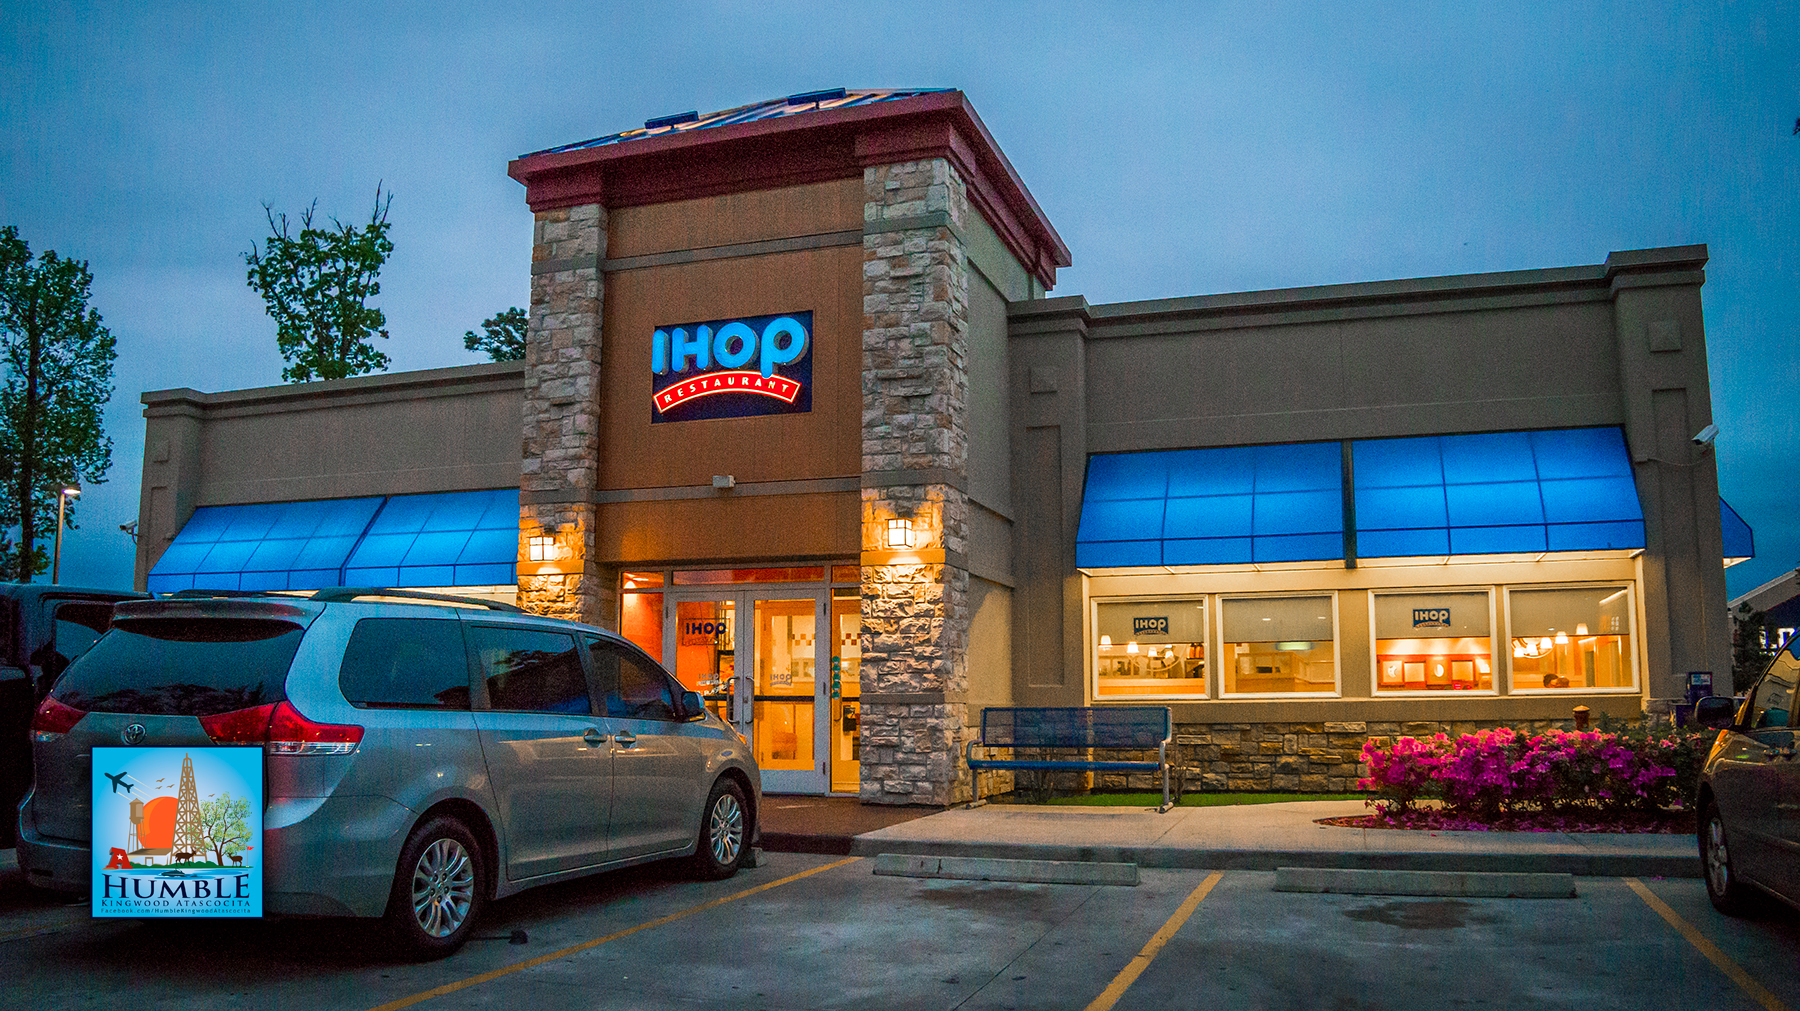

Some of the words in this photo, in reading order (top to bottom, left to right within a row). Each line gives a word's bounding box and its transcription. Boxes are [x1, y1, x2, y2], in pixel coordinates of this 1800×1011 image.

[651, 317, 809, 378] IHOP
[664, 376, 789, 403] RESTAURANT
[1135, 618, 1167, 631] IHOP
[1414, 610, 1449, 623] IHOP
[686, 622, 726, 639] IHOP
